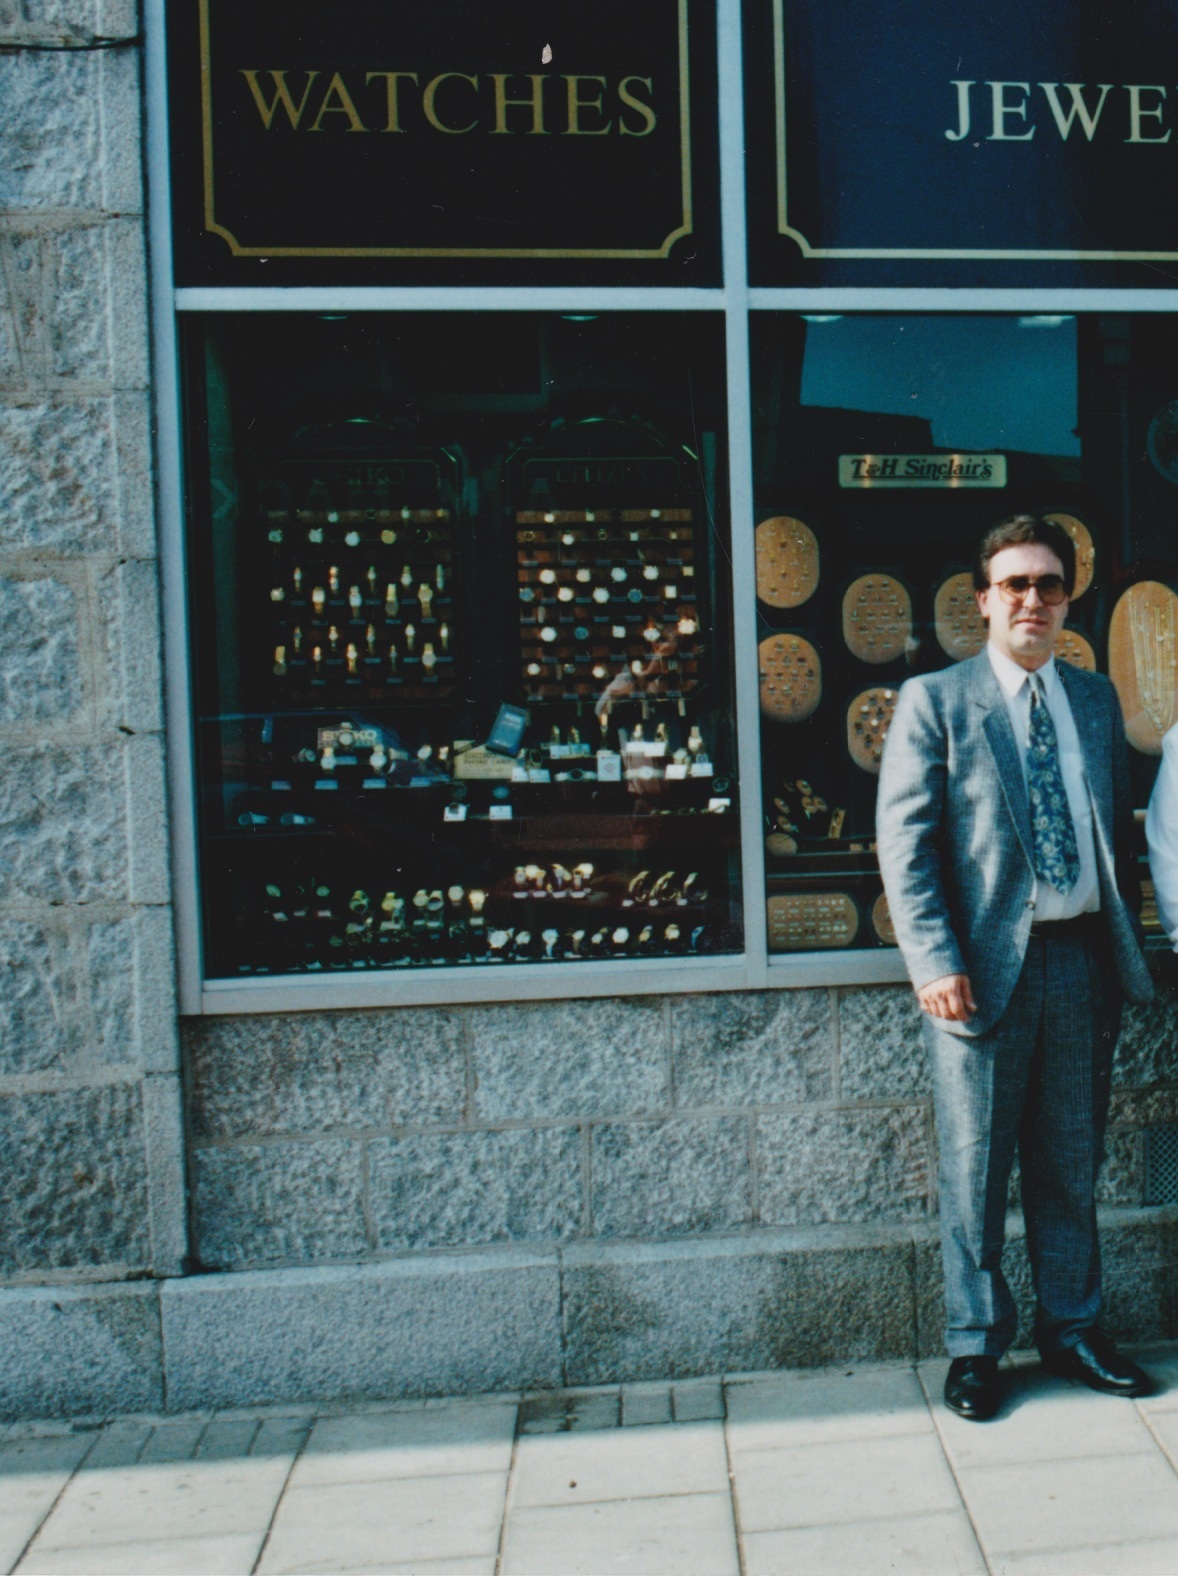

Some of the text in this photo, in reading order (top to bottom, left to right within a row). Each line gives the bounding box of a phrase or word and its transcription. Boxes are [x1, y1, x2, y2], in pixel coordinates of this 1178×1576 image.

[238, 69, 658, 138] WATCHES
[851, 458, 993, 481] T&H Sinclair's
